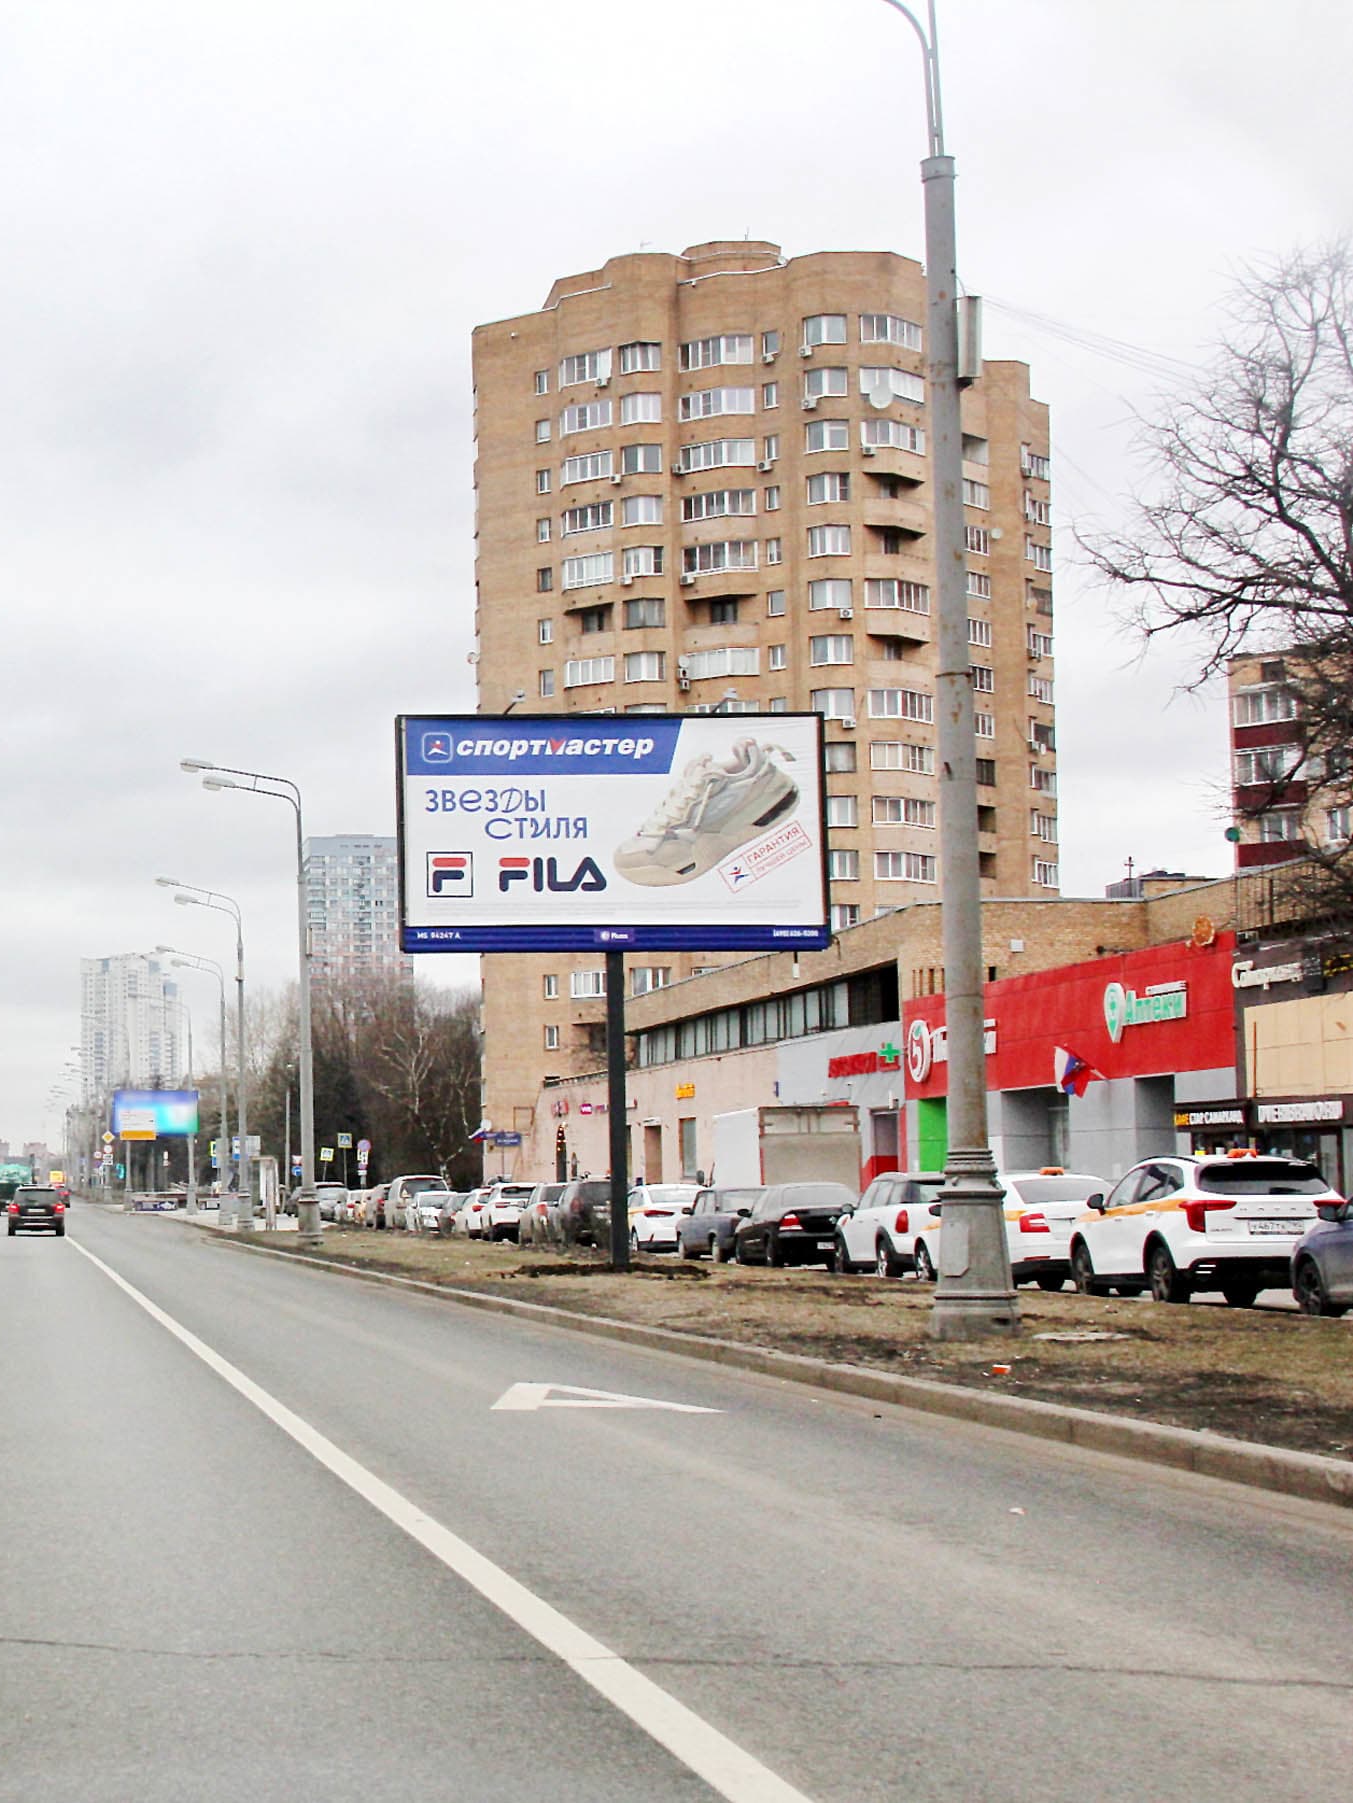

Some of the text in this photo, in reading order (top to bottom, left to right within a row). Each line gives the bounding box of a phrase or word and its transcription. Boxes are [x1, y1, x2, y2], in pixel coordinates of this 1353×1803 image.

[456, 737, 655, 760] спортмастер
[484, 817, 588, 840] СТИЛЯ
[746, 827, 800, 863] ГАРАНТИЯ
[498, 856, 608, 892] FILA
